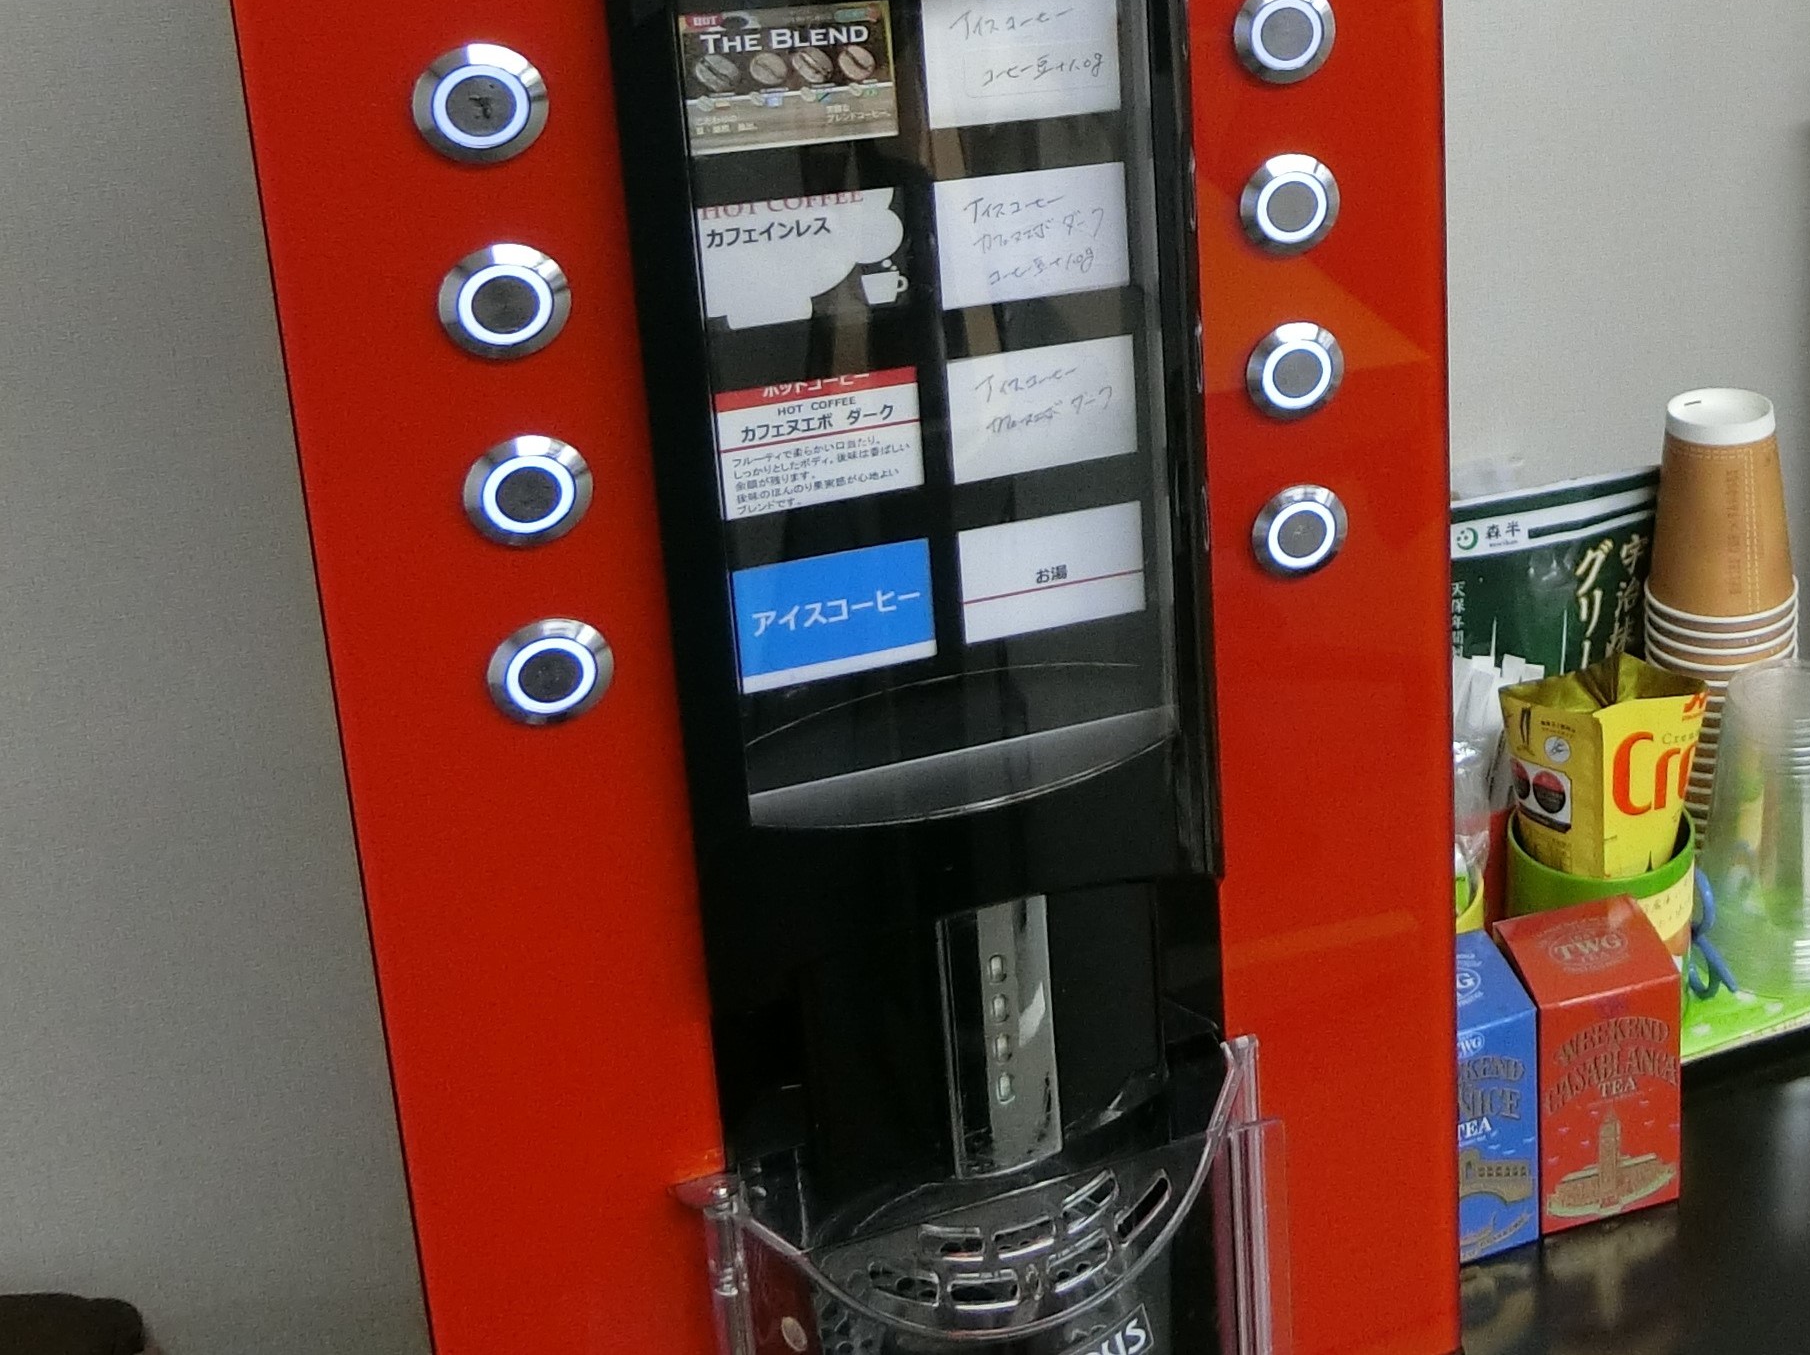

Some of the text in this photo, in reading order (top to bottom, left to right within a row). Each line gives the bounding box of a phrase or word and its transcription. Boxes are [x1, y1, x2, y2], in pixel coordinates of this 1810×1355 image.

[700, 25, 869, 55] THE BLEND
[701, 190, 864, 220] HOT COFFEE
[706, 217, 831, 248] カフェインレス
[777, 396, 857, 417] HOT COFFEE
[740, 404, 894, 443] カフェヌエボ ダーク
[1485, 520, 1521, 541] 森半
[1035, 564, 1069, 586] お湯
[751, 589, 922, 637] アイスコーヒー
[1554, 934, 1622, 960] TWG
[1554, 1016, 1670, 1066] WEEKEND
[1546, 1046, 1680, 1116] CASABLANCA
[1598, 1076, 1637, 1098] TEA
[1458, 1087, 1522, 1121] NICE
[1457, 1116, 1492, 1142] TEA
